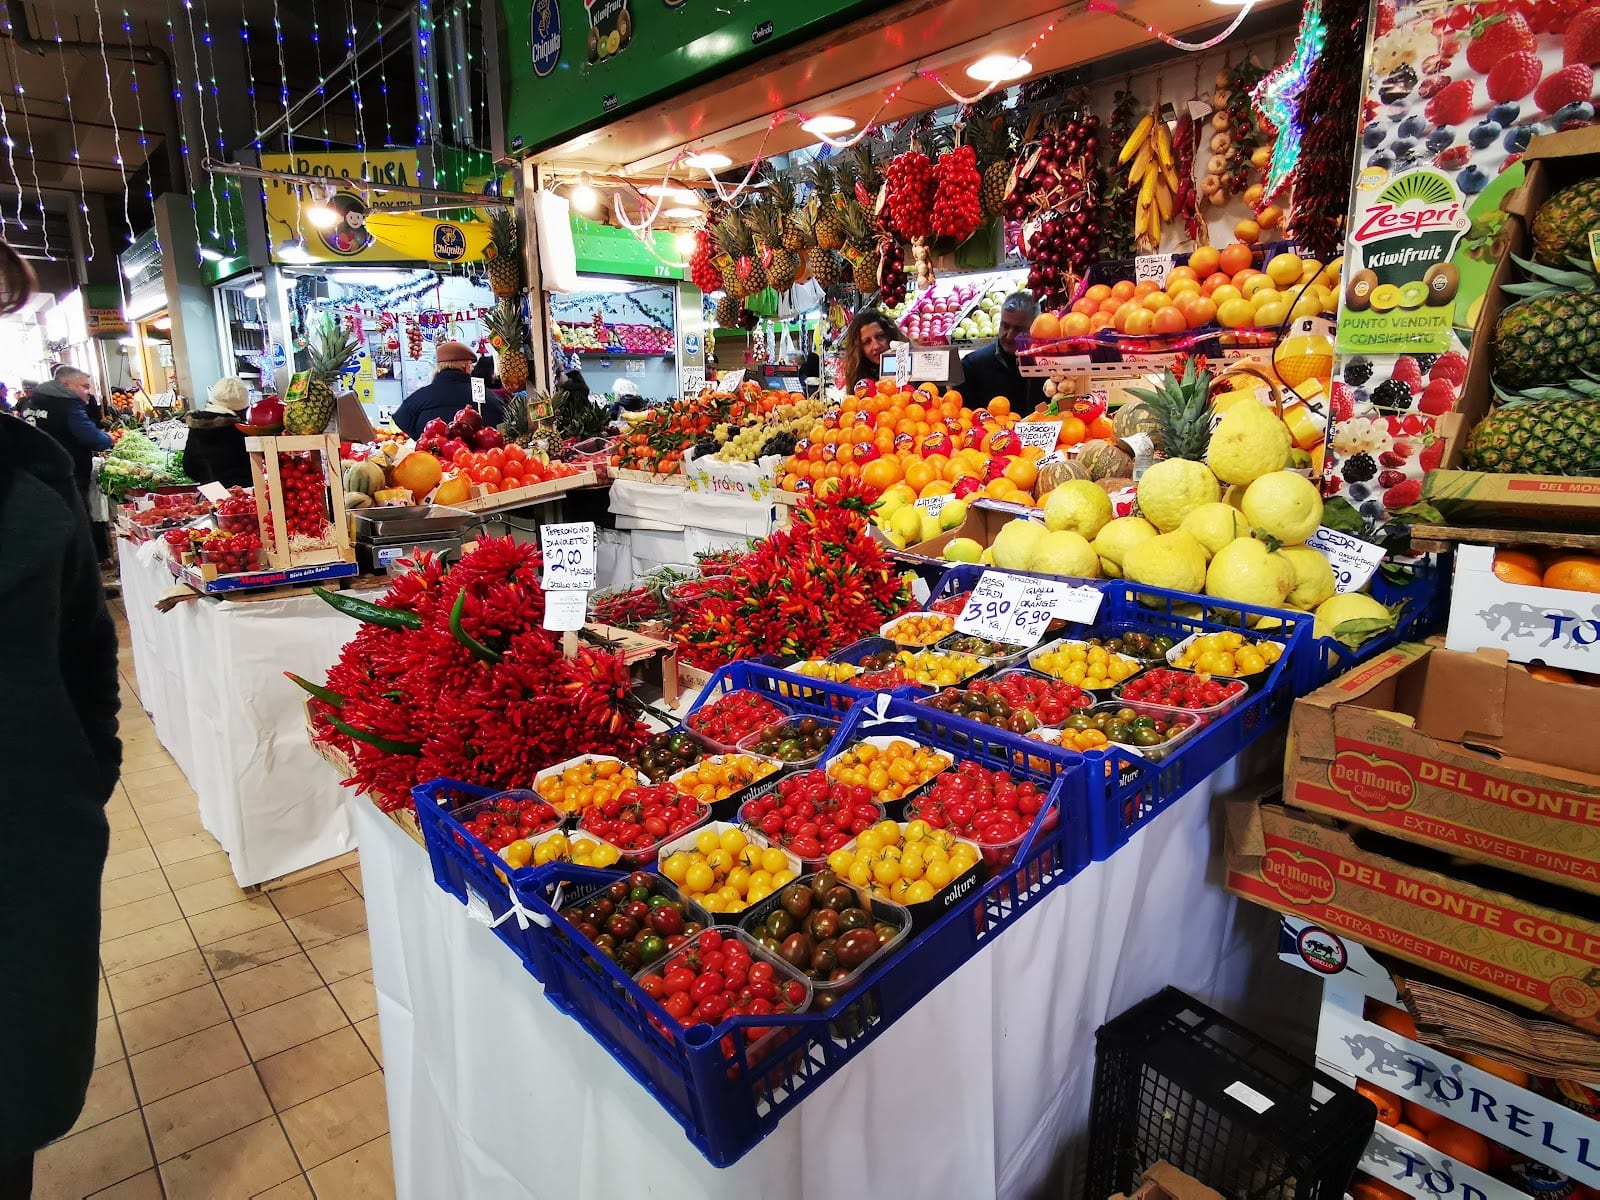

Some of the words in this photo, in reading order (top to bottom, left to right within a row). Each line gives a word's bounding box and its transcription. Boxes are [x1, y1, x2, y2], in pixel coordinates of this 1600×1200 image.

[532, 30, 561, 63] Chiquita
[1355, 203, 1459, 241] Zespri
[434, 243, 464, 257] Chiquita
[1368, 244, 1442, 268] Kiwifruit
[655, 265, 670, 277] 176
[1343, 317, 1387, 329] PUNTO
[1391, 315, 1448, 328] VENDITA
[1350, 331, 1435, 345] CONSIGLIATO
[1539, 482, 1564, 491] DEL
[1316, 529, 1363, 553] CEDRI
[975, 587, 1003, 599] VERDI
[1020, 599, 1059, 608] ORANGE
[1035, 593, 1042, 601] E
[963, 600, 1012, 625] 3,90
[1335, 763, 1359, 783] Del
[1362, 772, 1411, 797] Monte
[1419, 761, 1480, 793] DEL
[1354, 784, 1386, 802] Quality
[1403, 815, 1458, 841] EXTRA
[1464, 831, 1529, 859] SWEET
[1265, 857, 1286, 876] Del
[1287, 865, 1331, 892] Monte
[944, 874, 977, 906] colture
[1338, 860, 1387, 890] DEL
[1396, 880, 1502, 927] MONTE
[1308, 953, 1334, 970] TORELLO
[1324, 909, 1373, 936] EXTRA
[1377, 927, 1439, 957] SWEET
[1439, 949, 1539, 996] PINEAPPLE
[1405, 1058, 1600, 1172] TORELL
